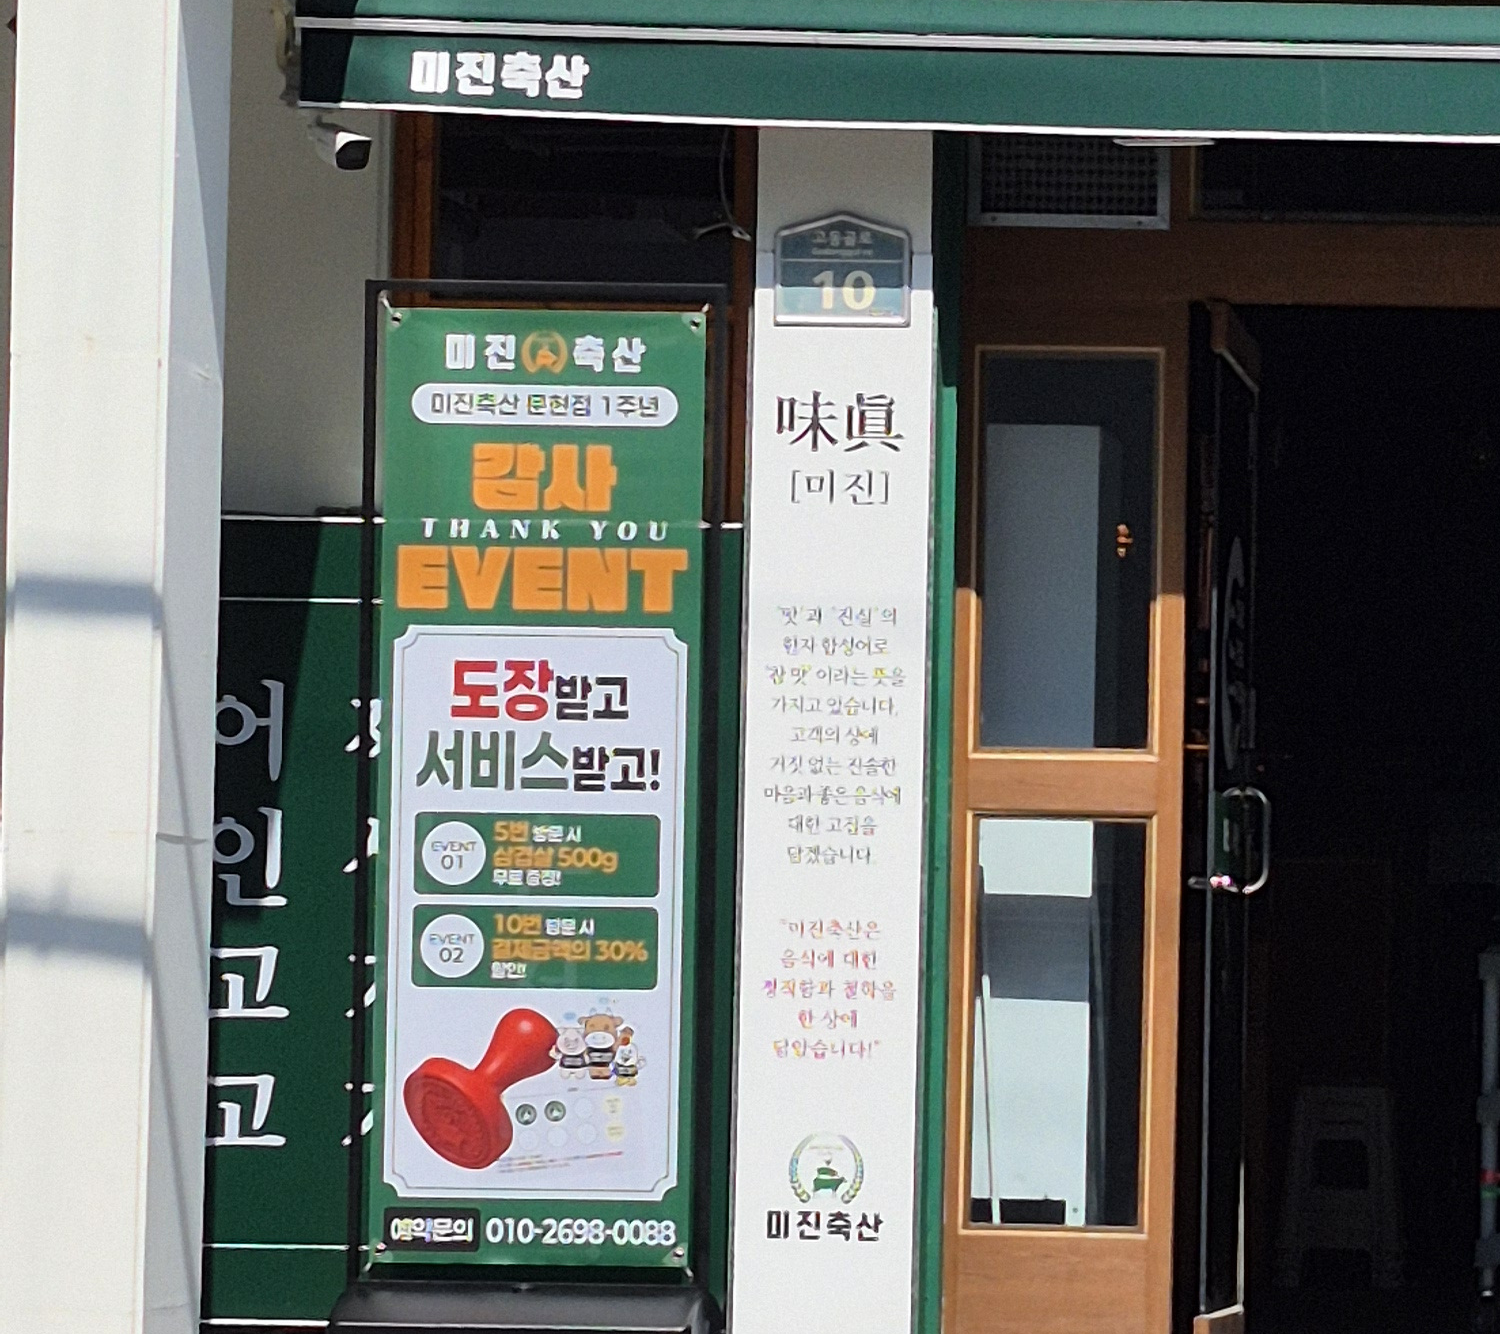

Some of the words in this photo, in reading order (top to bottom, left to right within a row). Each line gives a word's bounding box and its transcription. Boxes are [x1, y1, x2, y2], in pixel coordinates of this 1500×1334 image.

[409, 49, 590, 99] 미진축산
[812, 270, 877, 311] 10
[445, 332, 517, 371] 미진
[572, 334, 647, 374] 축산
[430, 392, 520, 416] 미진축산
[525, 393, 592, 417] 문현점
[471, 442, 617, 512] 감사
[790, 468, 890, 505] [미진]
[420, 517, 562, 540] THANK
[589, 520, 670, 542] YOU
[397, 544, 690, 614] EVENT
[449, 658, 630, 722] 도장받고
[415, 729, 661, 792] 서비스받고!
[431, 841, 477, 853] EVENT
[441, 854, 465, 870] 01
[557, 846, 620, 874] 500g
[429, 933, 475, 945] EVENT
[594, 939, 649, 963] 30%
[438, 947, 465, 964] 02
[485, 1216, 677, 1247] 010-2698-0088
[764, 1209, 885, 1243] 미진축산
